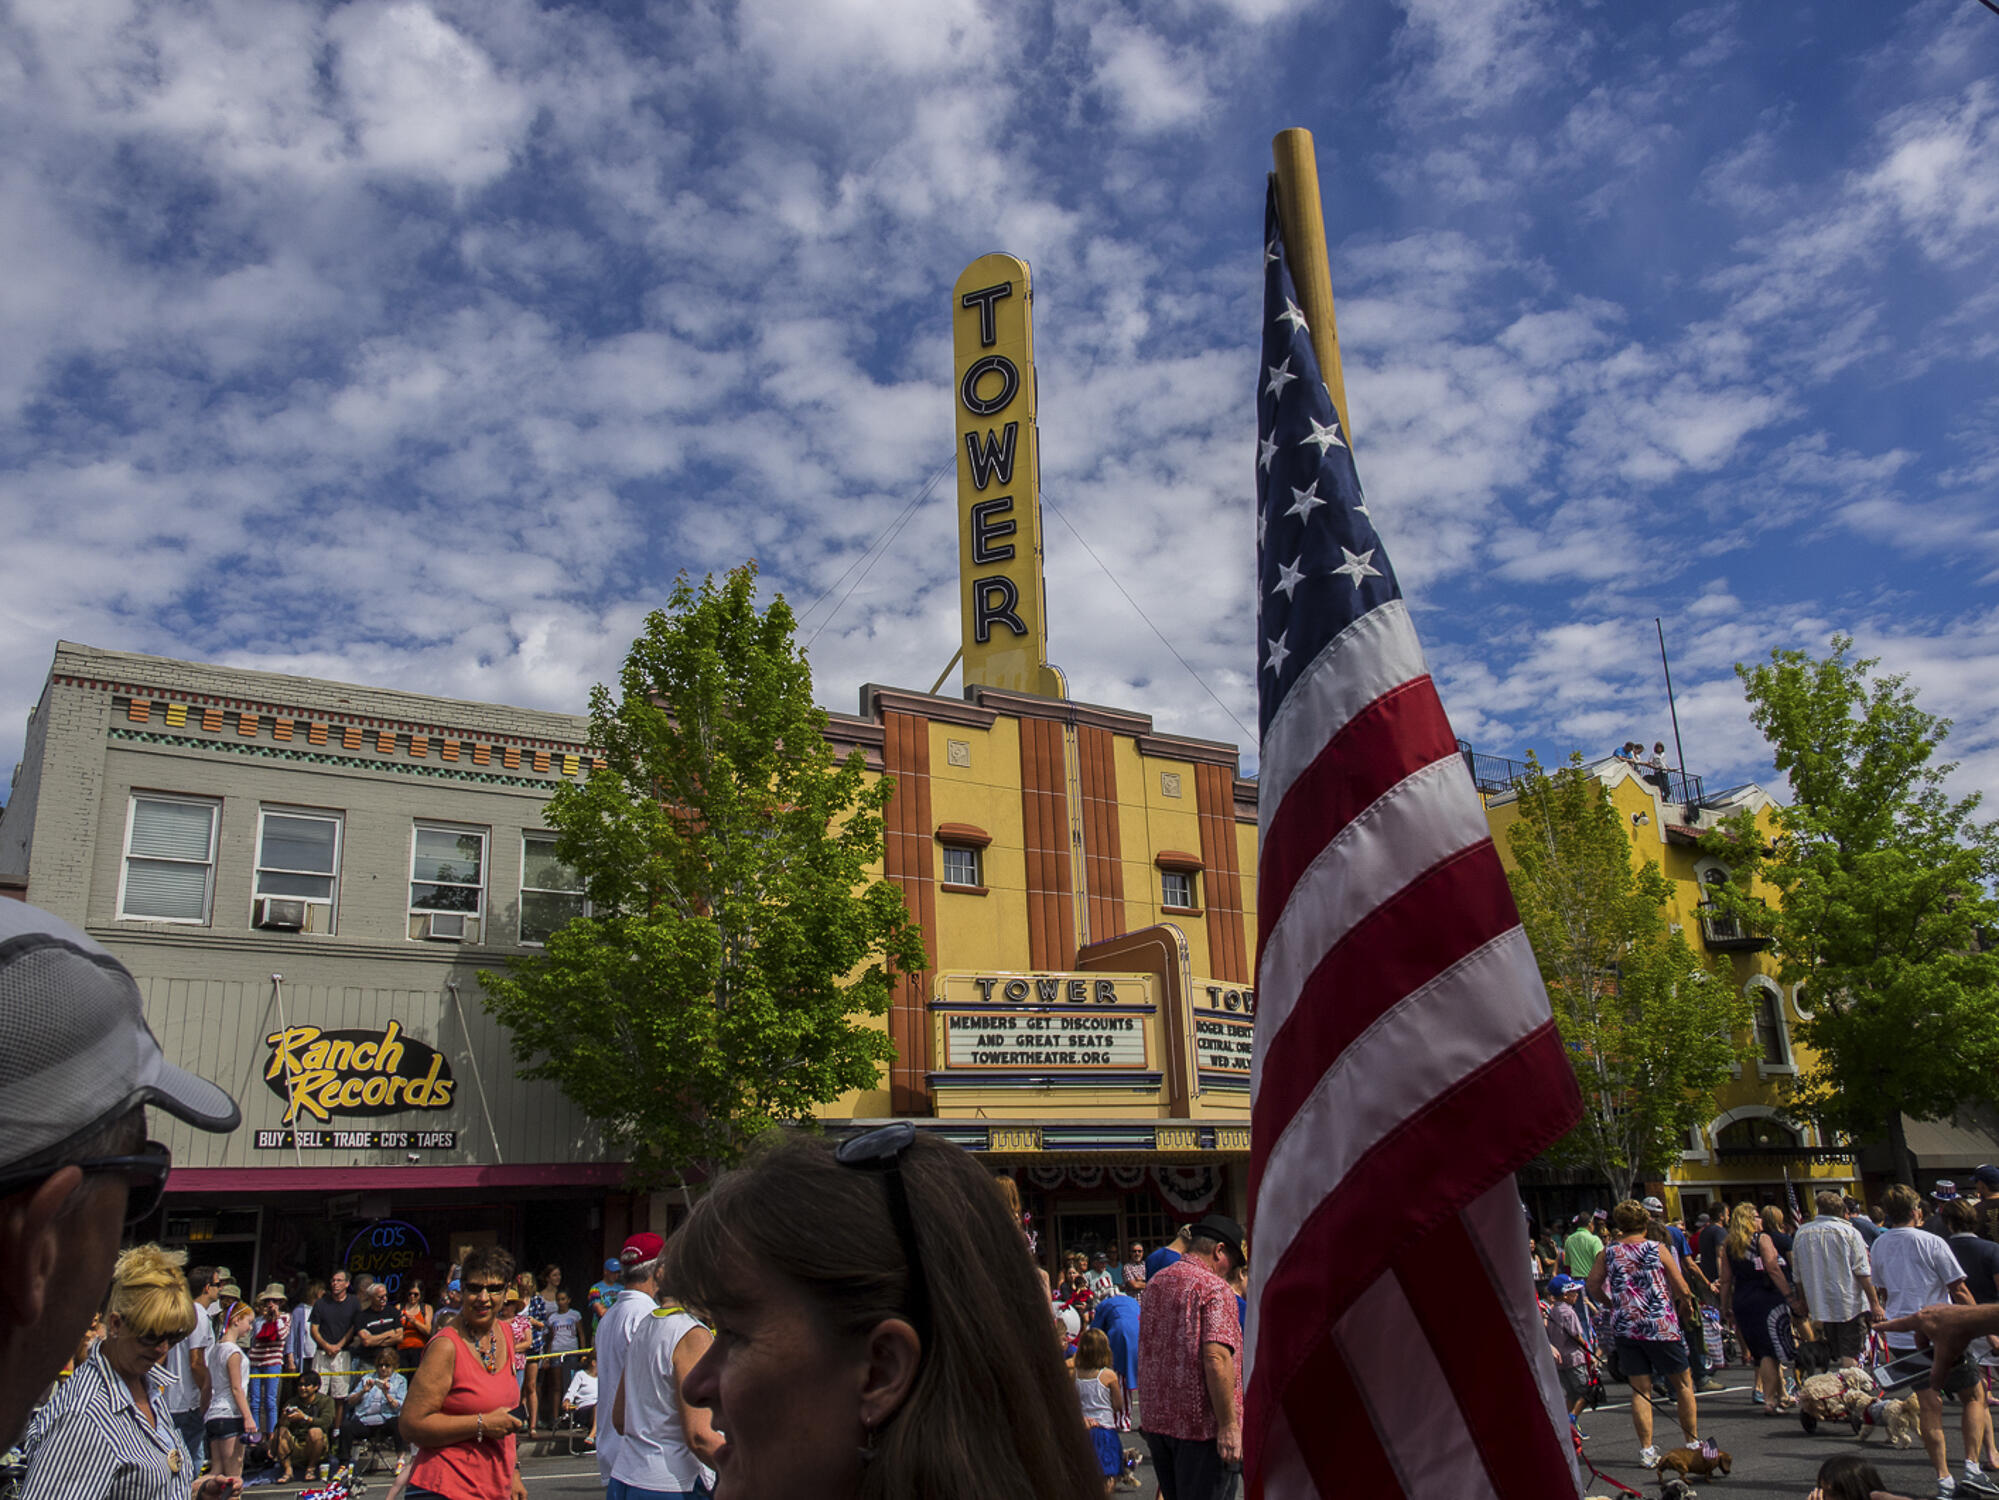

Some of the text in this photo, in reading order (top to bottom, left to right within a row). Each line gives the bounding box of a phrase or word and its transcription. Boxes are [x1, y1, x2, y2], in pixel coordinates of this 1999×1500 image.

[961, 281, 1029, 644] TOWER
[976, 978, 1118, 1003] TOWER
[1207, 987, 1254, 1012] TOW
[949, 1016, 1017, 1030] MEMBERS
[1026, 1016, 1051, 1030] GET
[976, 1034, 1114, 1048] AND GREAT SEATS
[1198, 1039, 1234, 1051] CENTRAL
[265, 1019, 406, 1081] Ranch
[971, 1051, 1111, 1065] TOWERTHEATRE.ORG
[1210, 1056, 1229, 1068] WED
[282, 1052, 456, 1125] Records
[258, 1131, 454, 1148] BUY SELL TRADE CD'S TAPES
